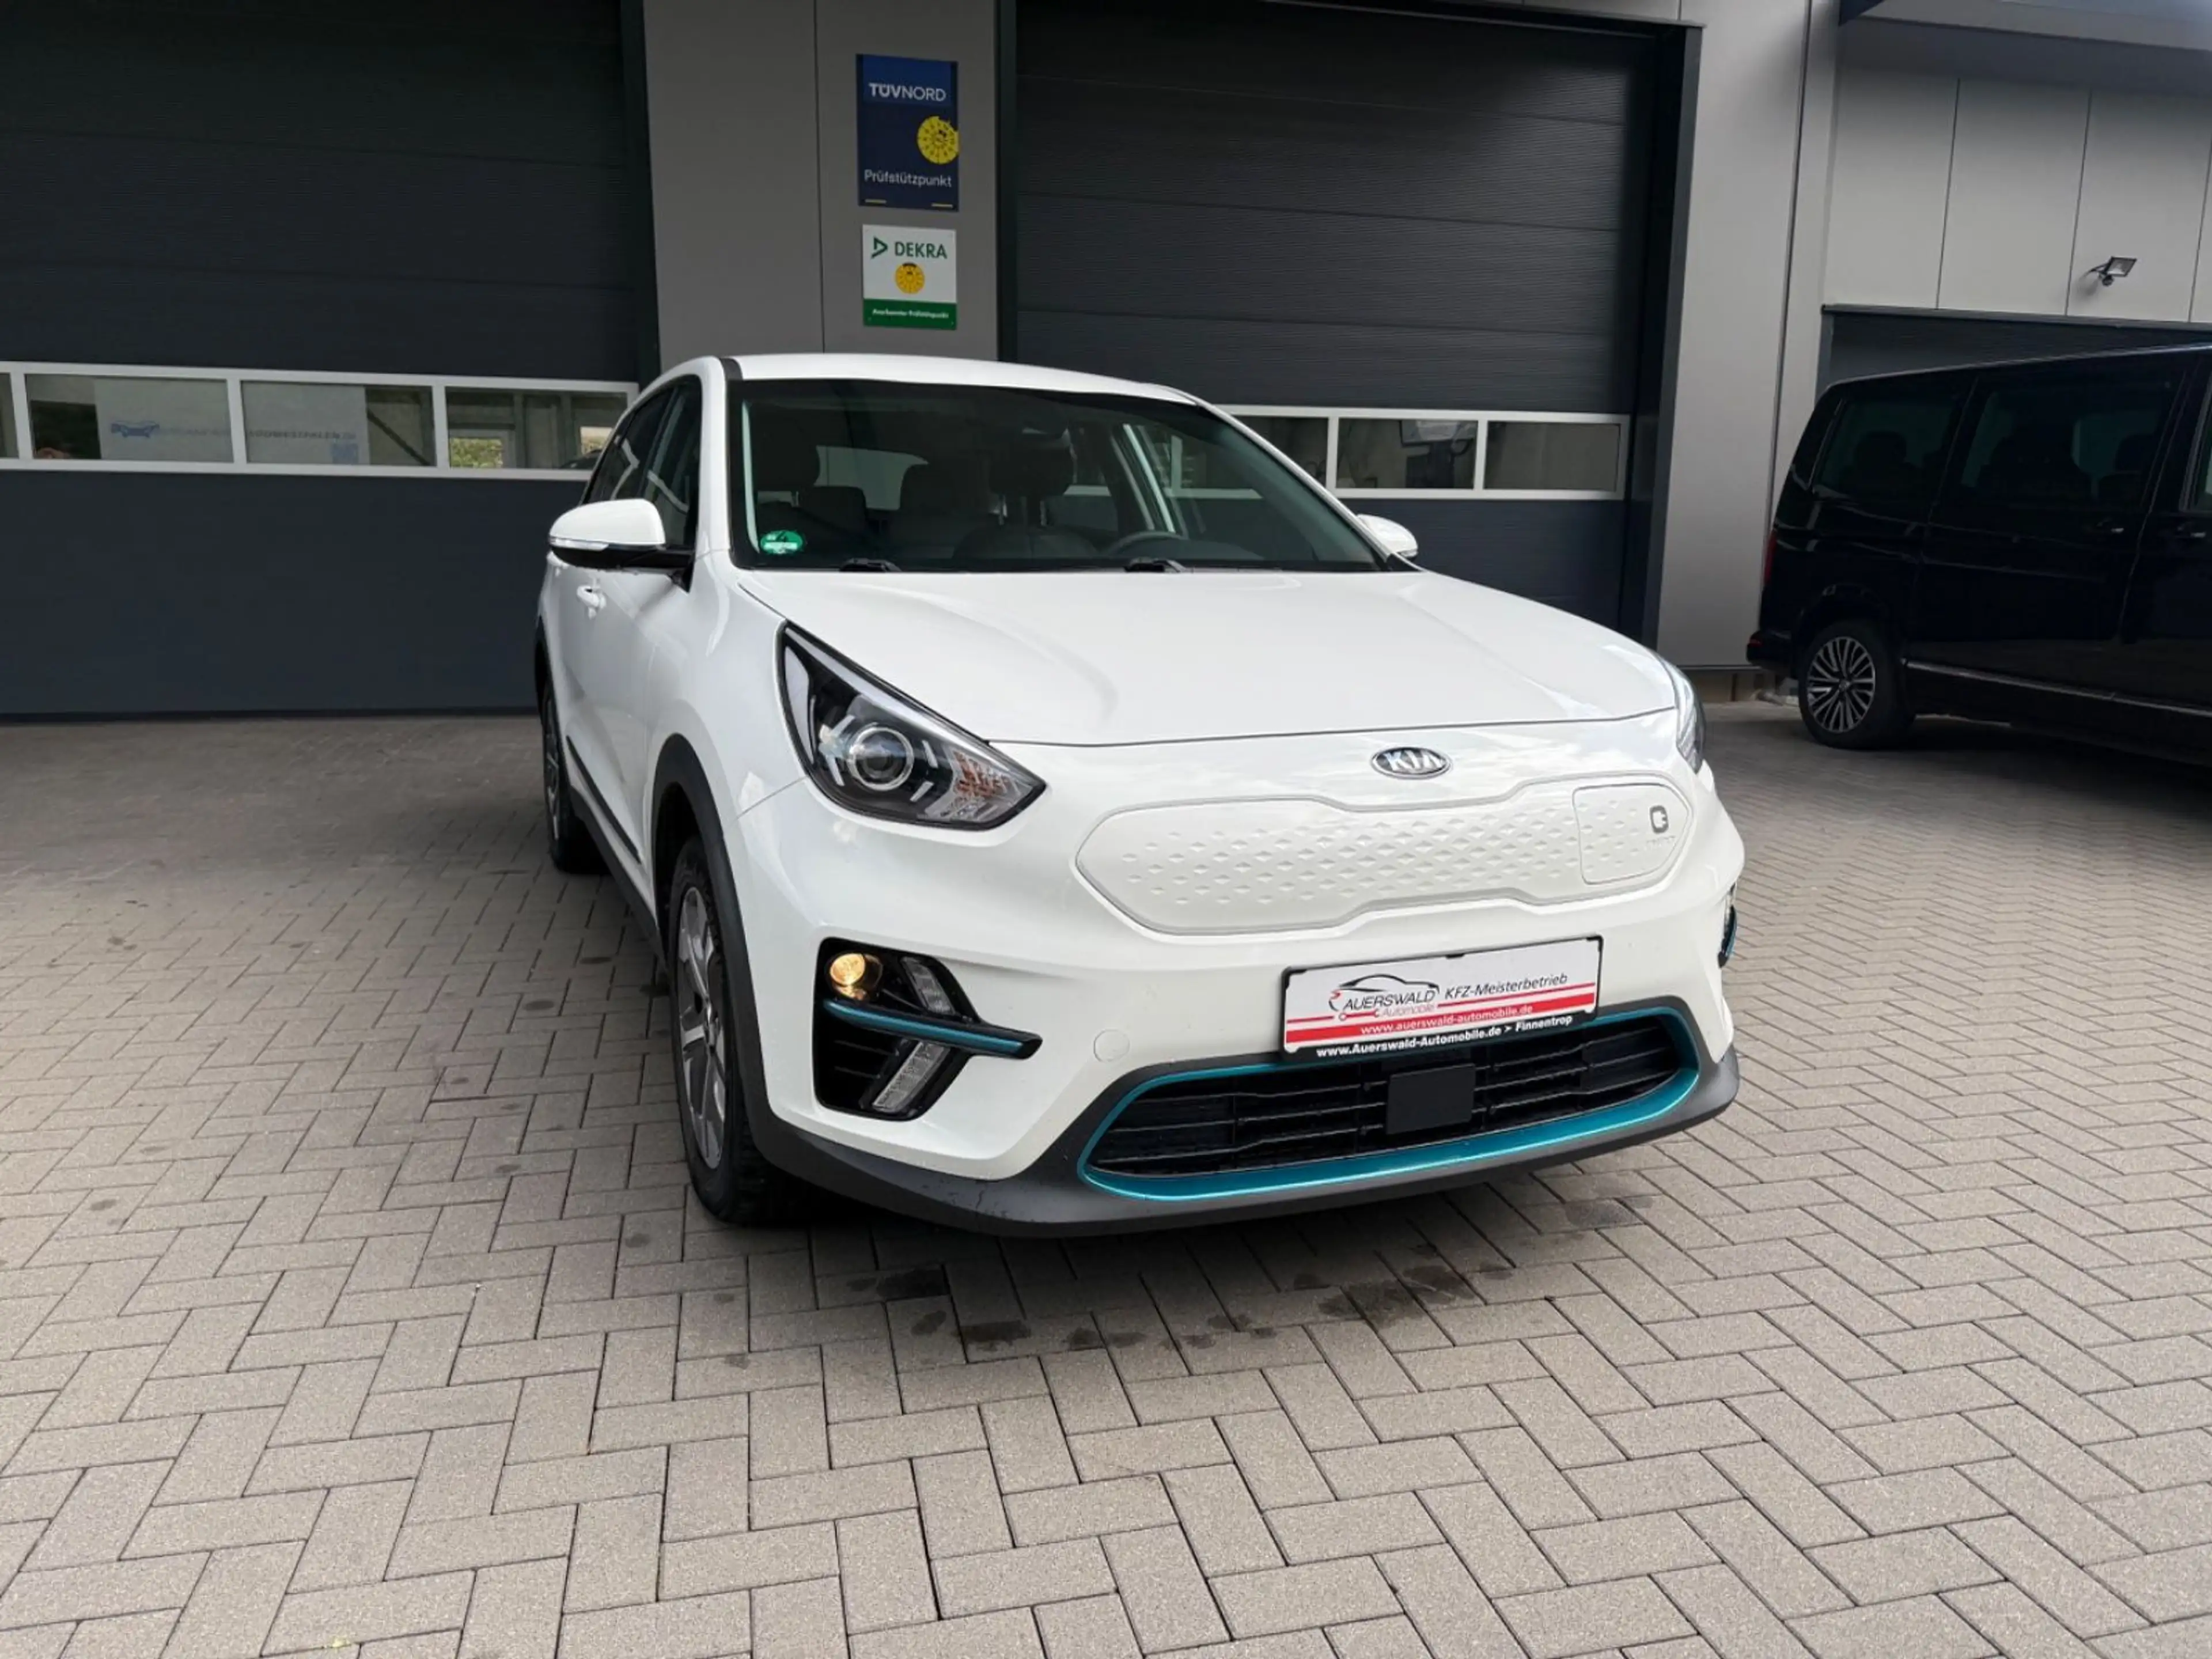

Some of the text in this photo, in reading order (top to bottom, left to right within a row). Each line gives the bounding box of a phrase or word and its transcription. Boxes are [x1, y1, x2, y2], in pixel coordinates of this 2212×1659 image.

[864, 169, 952, 188] Prüfstützpunkt
[894, 241, 948, 260] DEKRA
[1383, 749, 1442, 771] KIA
[1445, 972, 1568, 999] KFZ-Meisterbetrieb
[1343, 989, 1436, 1011] AUERSWALD
[1360, 1005, 1533, 1035] www.auerswald-automobile.de
[1316, 1026, 1501, 1058] www.Auerswald-Automobile.de
[1515, 1015, 1573, 1032] Finnentrop
